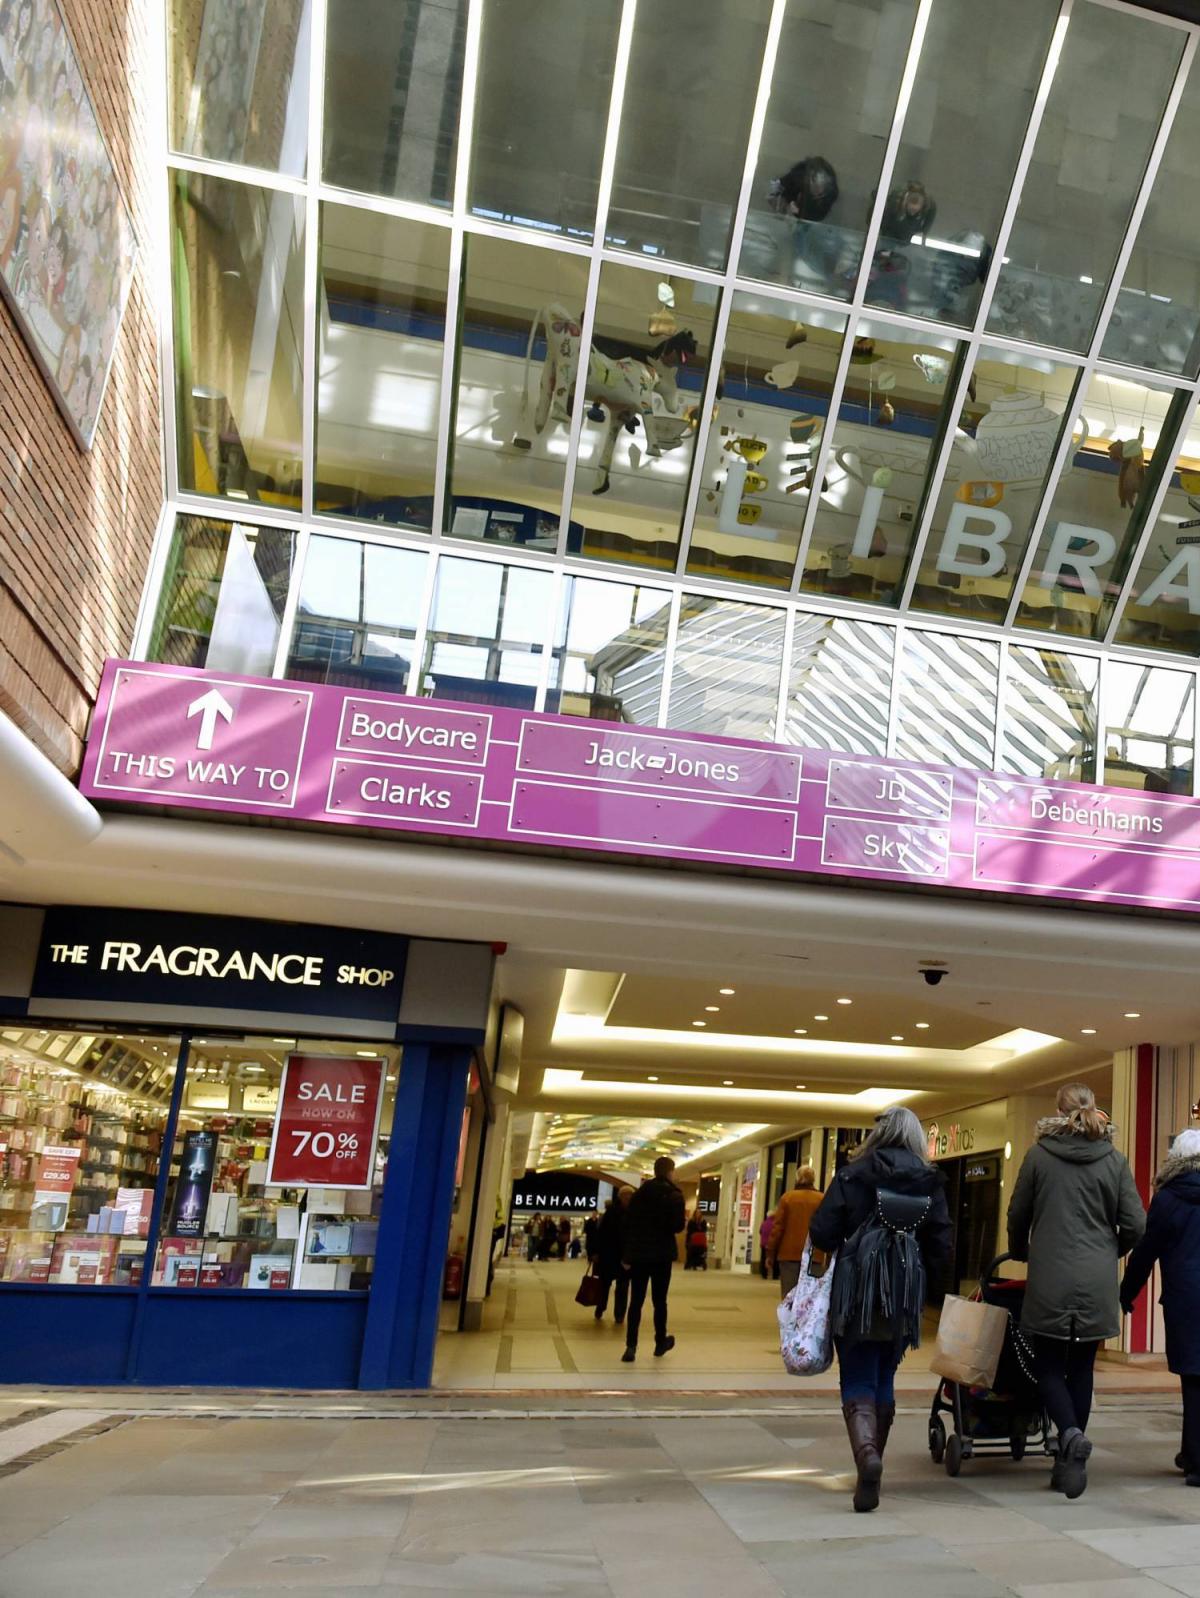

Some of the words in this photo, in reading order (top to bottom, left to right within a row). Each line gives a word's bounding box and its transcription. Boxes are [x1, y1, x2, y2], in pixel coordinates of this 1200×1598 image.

[351, 714, 477, 751] Bodycare
[110, 751, 175, 778] THIS
[186, 760, 245, 784] WAY
[254, 768, 290, 791] TO
[360, 777, 452, 809] Clarks
[875, 779, 906, 801] JD
[1030, 800, 1163, 833] Debenhams
[864, 834, 910, 863] Sky
[50, 944, 88, 965] THE
[101, 941, 323, 986] FRAGRANCE
[336, 965, 394, 987] SHOP
[298, 1082, 366, 1104] SALE
[302, 1108, 334, 1119] NOW
[337, 1110, 356, 1121] ON
[335, 1150, 357, 1159] OFF
[515, 1194, 597, 1207] BENHAMS
